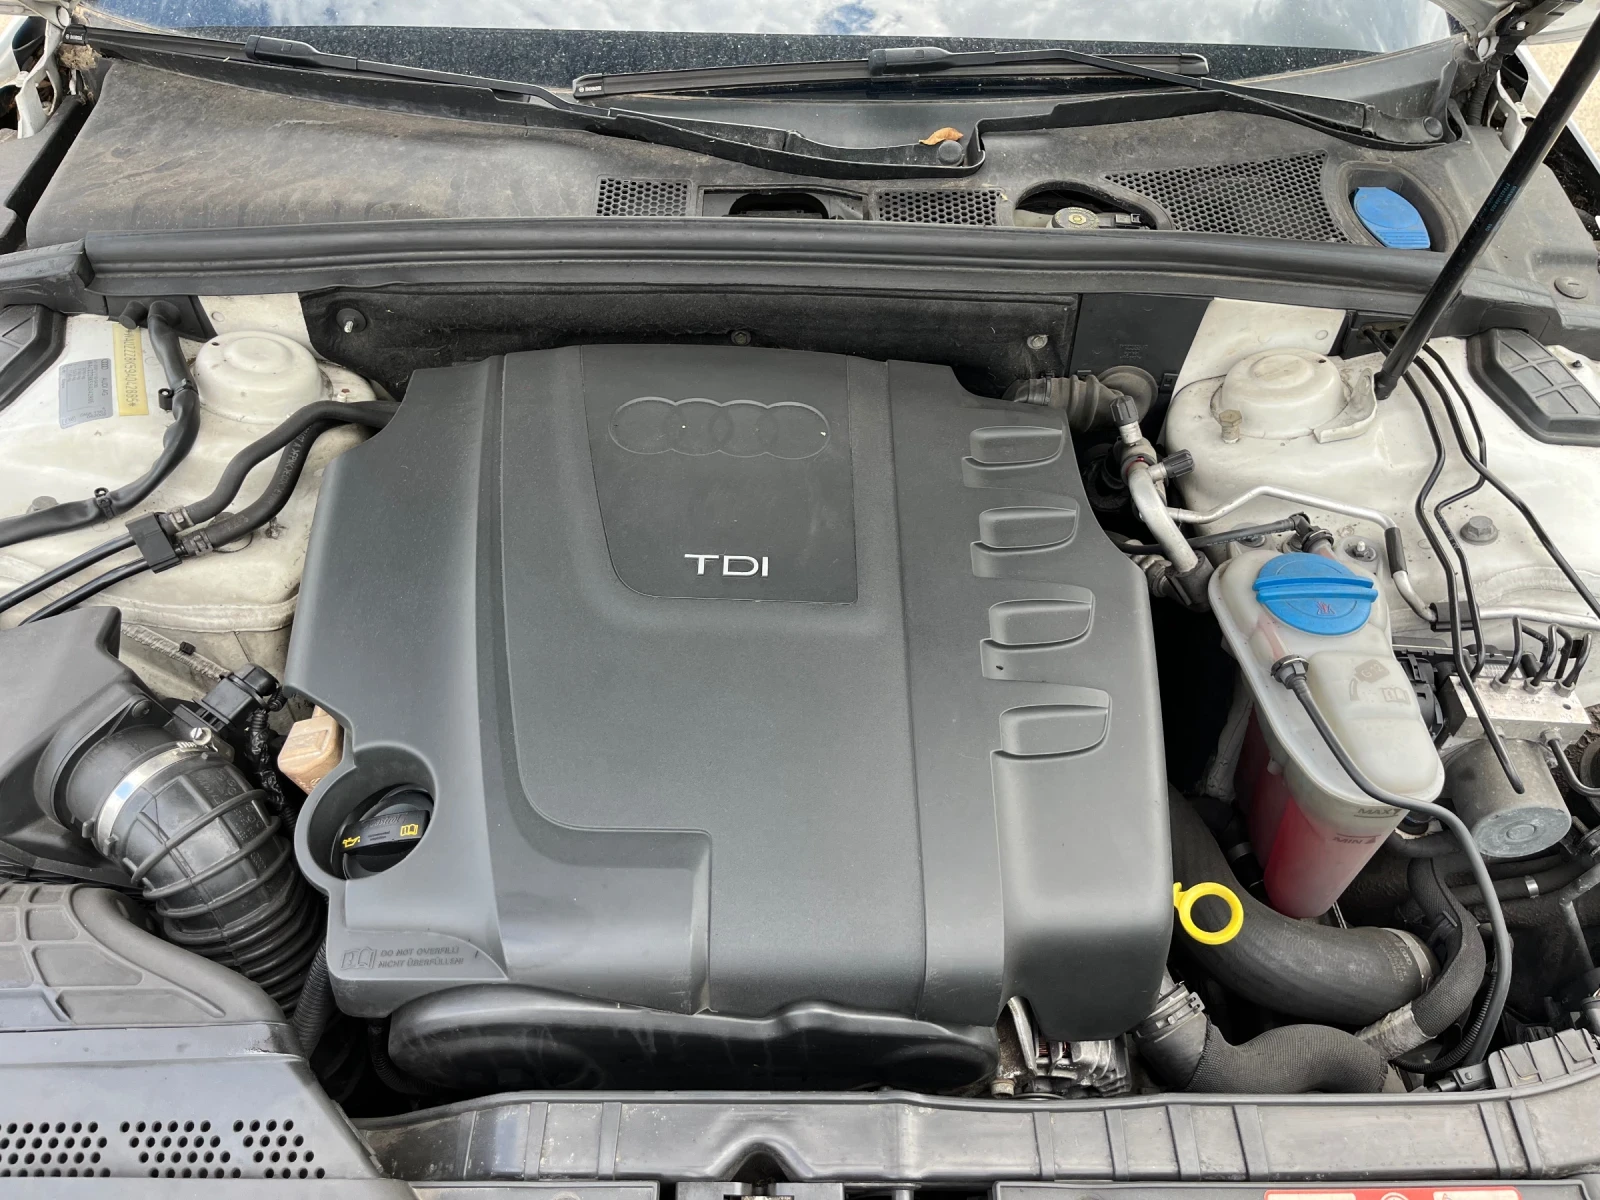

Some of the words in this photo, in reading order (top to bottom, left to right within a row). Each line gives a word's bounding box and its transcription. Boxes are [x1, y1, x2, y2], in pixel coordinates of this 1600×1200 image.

[101, 389, 109, 397] AG
[684, 553, 769, 577] TDI
[1332, 836, 1364, 844] MIN
[380, 949, 394, 957] DO
[396, 948, 414, 957] NOT
[416, 946, 460, 956] OVERFILL!
[377, 960, 405, 968] NICHT
[407, 957, 465, 967] ÜBERFÜLLEN!
